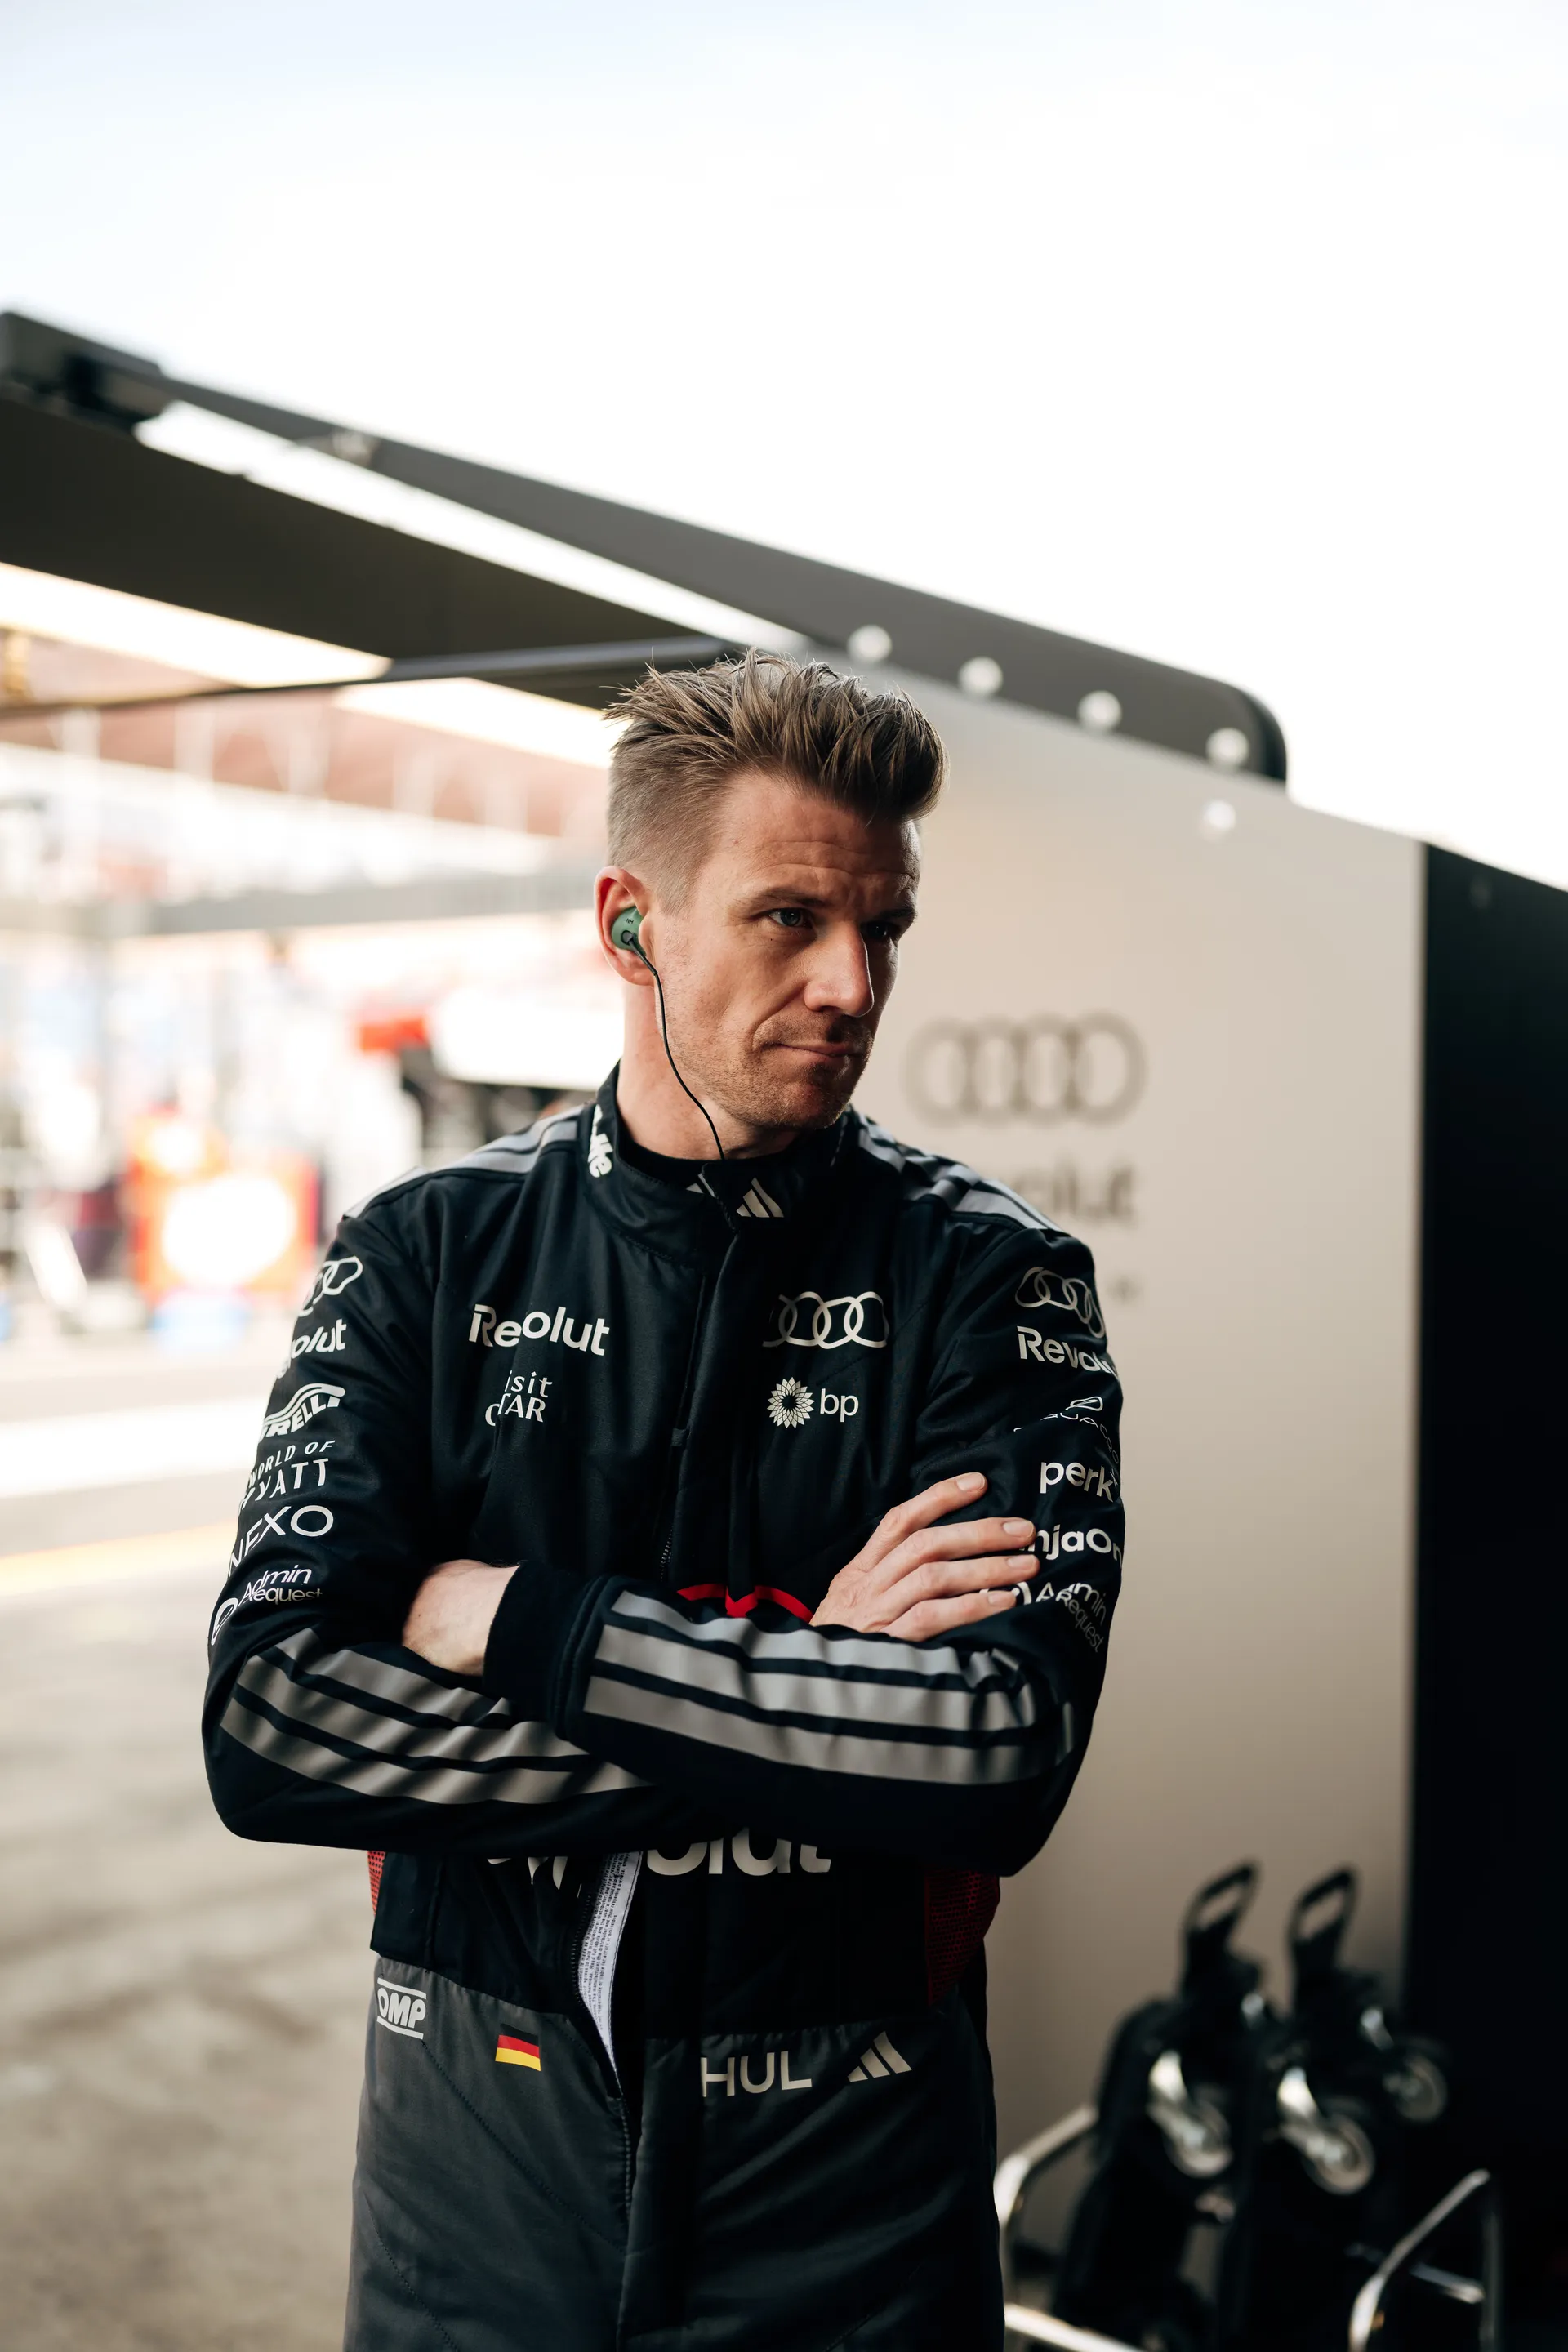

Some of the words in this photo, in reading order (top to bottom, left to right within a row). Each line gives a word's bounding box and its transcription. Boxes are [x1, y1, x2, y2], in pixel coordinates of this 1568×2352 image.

[469, 1304, 610, 1356] Reolut
[504, 1370, 553, 1398] isit
[820, 1388, 859, 1423] bp
[259, 1383, 345, 1442] IRELLI
[248, 1445, 296, 1489] WORLD
[304, 1440, 336, 1454] OF
[1040, 1461, 1114, 1503] perk
[238, 1564, 312, 1607] Admin
[377, 1985, 427, 2030] OMP
[700, 2051, 813, 2098] HUL
